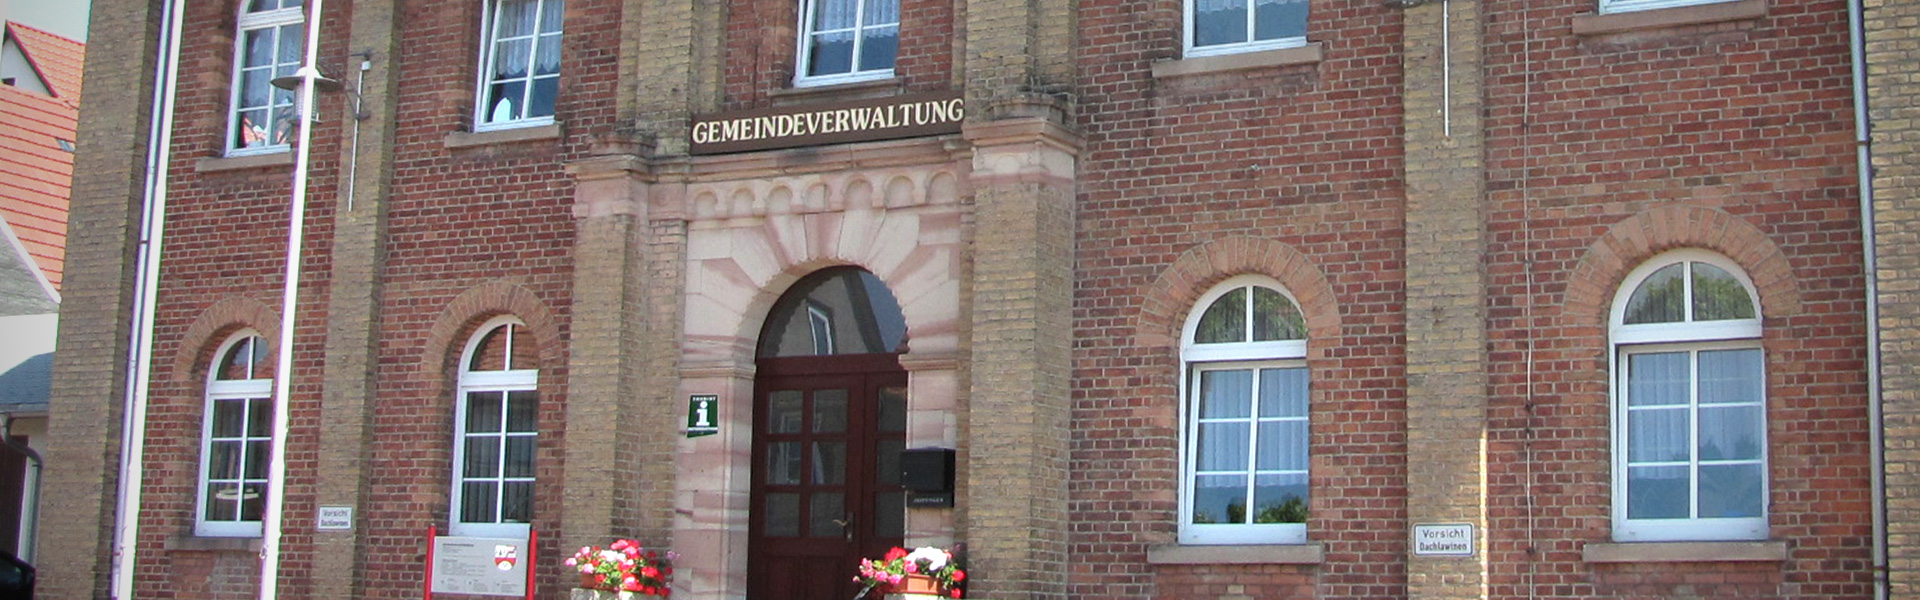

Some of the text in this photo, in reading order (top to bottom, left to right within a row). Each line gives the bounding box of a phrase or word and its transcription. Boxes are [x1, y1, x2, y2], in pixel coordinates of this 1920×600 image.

[692, 98, 964, 144] GEMEINDEVERWALTUNG
[1422, 529, 1465, 538] Vorsicht
[1420, 541, 1468, 551] Dachlawinen
